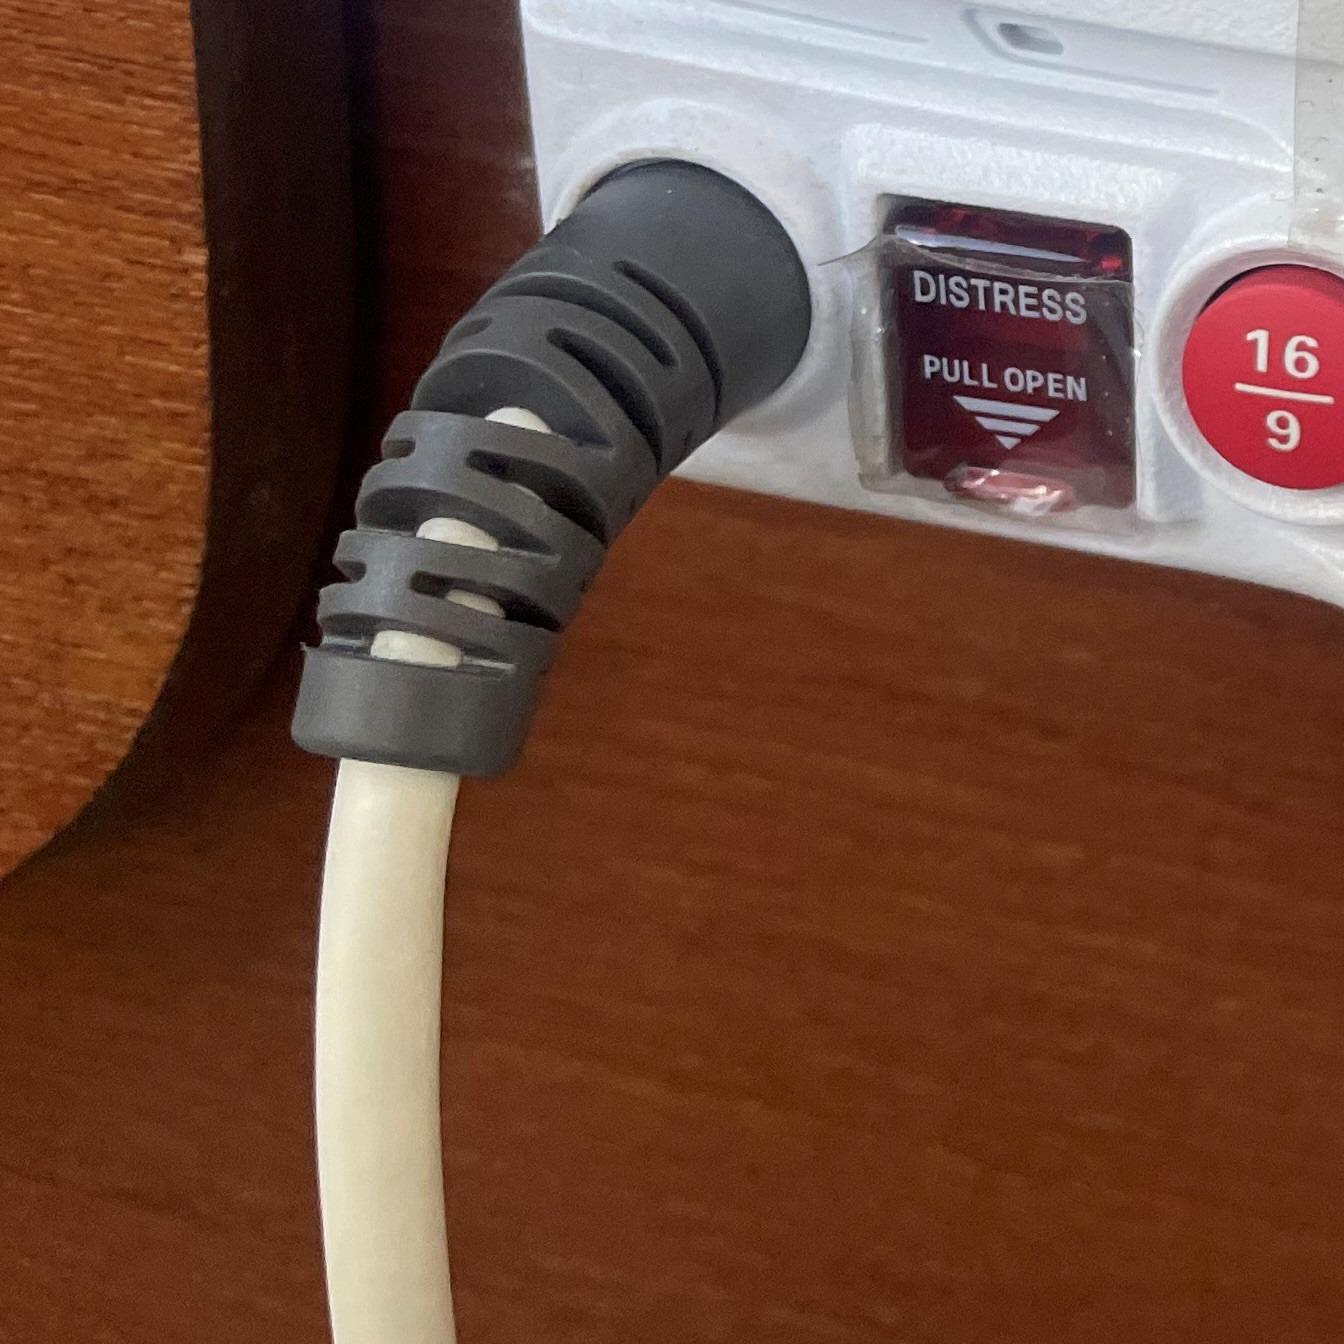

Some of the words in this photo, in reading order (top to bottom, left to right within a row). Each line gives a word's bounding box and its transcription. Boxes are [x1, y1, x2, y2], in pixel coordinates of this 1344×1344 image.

[912, 269, 1088, 326] DISTRESS
[923, 354, 998, 390] PULL
[1003, 366, 1088, 403] OPEN
[1244, 328, 1321, 380] 16
[1265, 409, 1302, 453] 9
